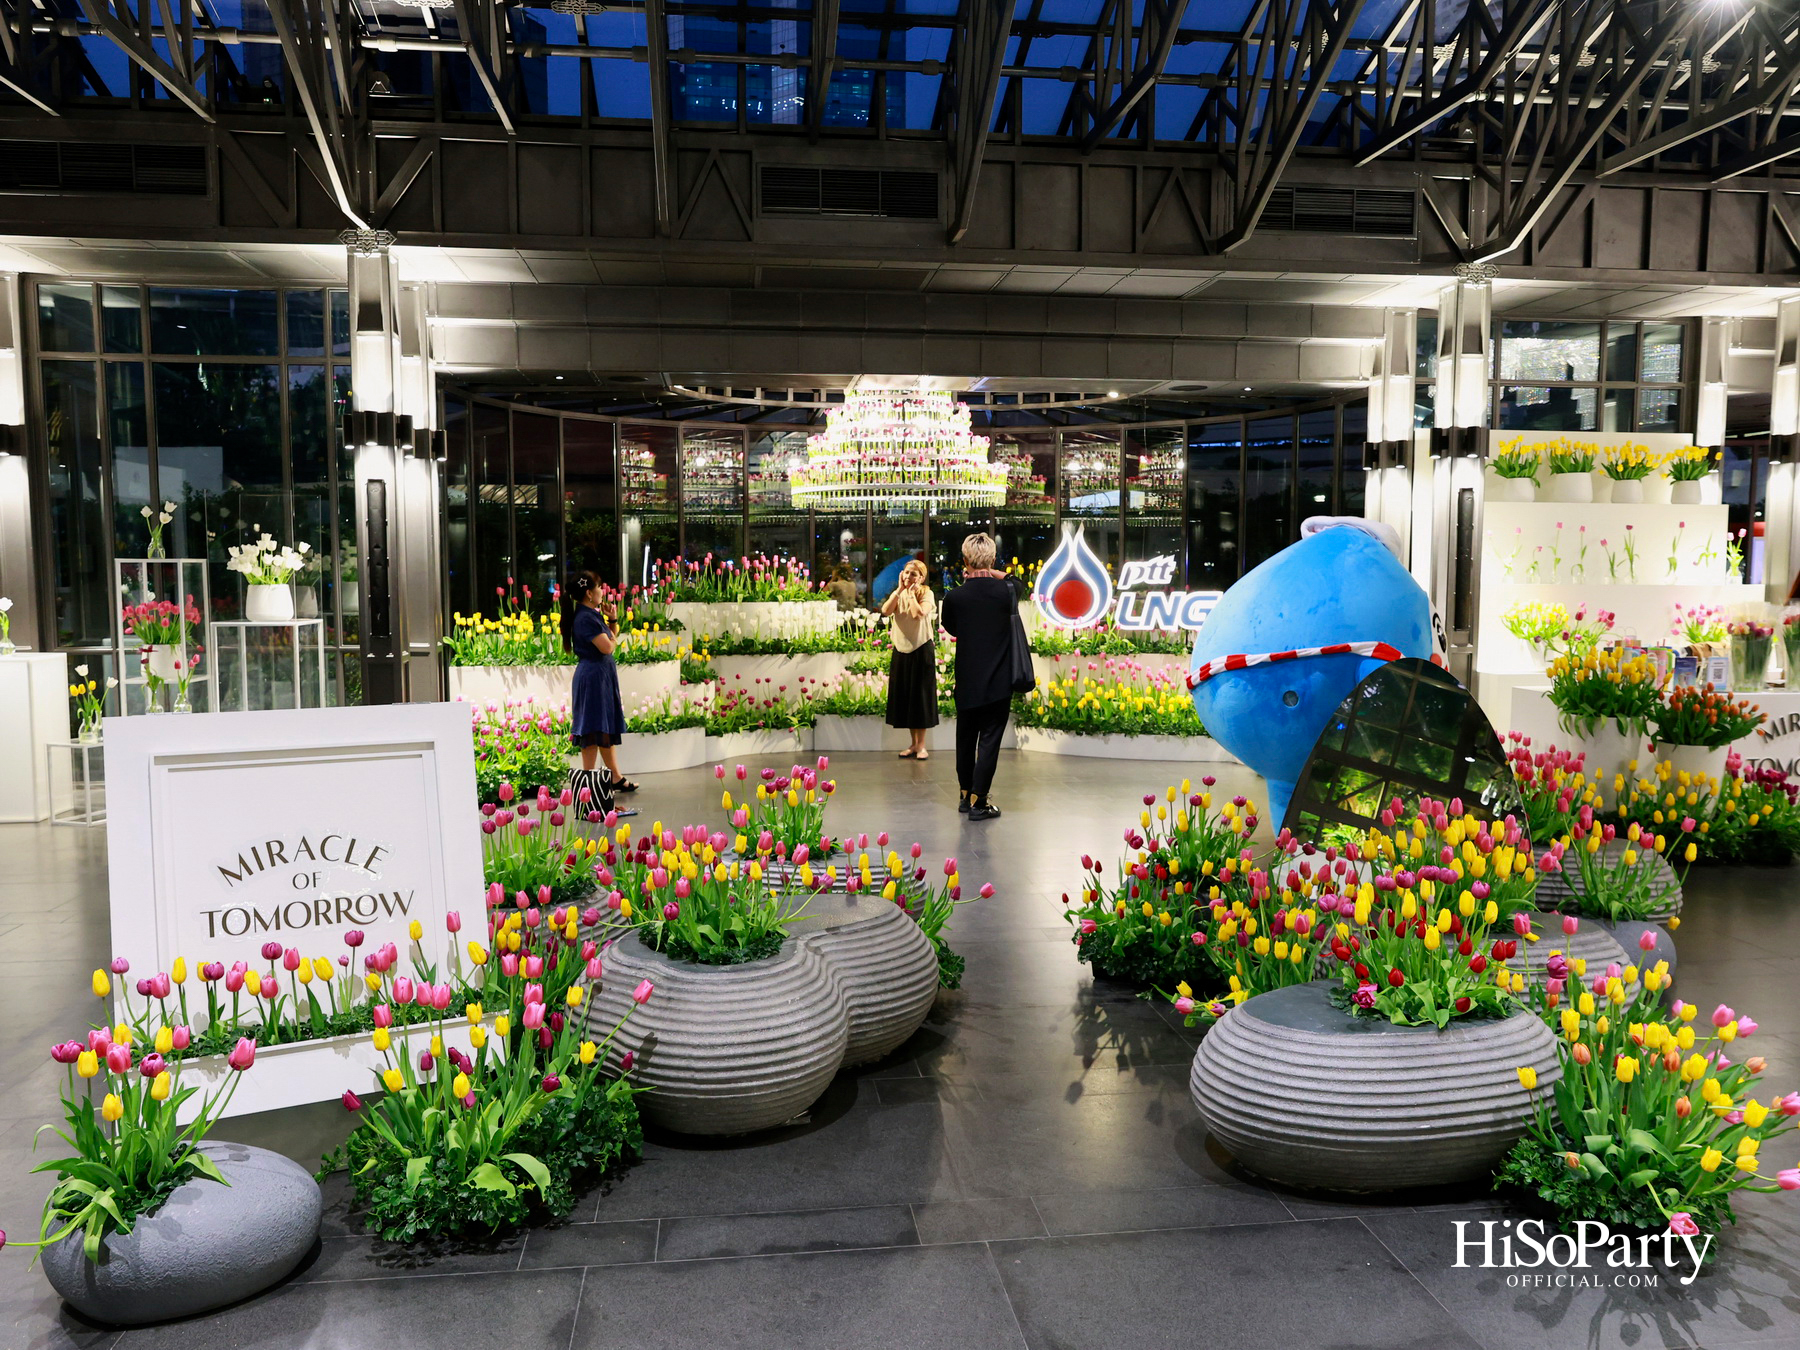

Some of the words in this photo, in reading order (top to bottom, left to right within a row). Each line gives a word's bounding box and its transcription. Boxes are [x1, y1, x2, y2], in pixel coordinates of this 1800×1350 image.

[1118, 555, 1176, 589] ptt
[1116, 592, 1222, 629] LNG
[217, 834, 389, 888] MIRACLE
[292, 871, 322, 890] OF
[200, 890, 415, 938] TOMORROW
